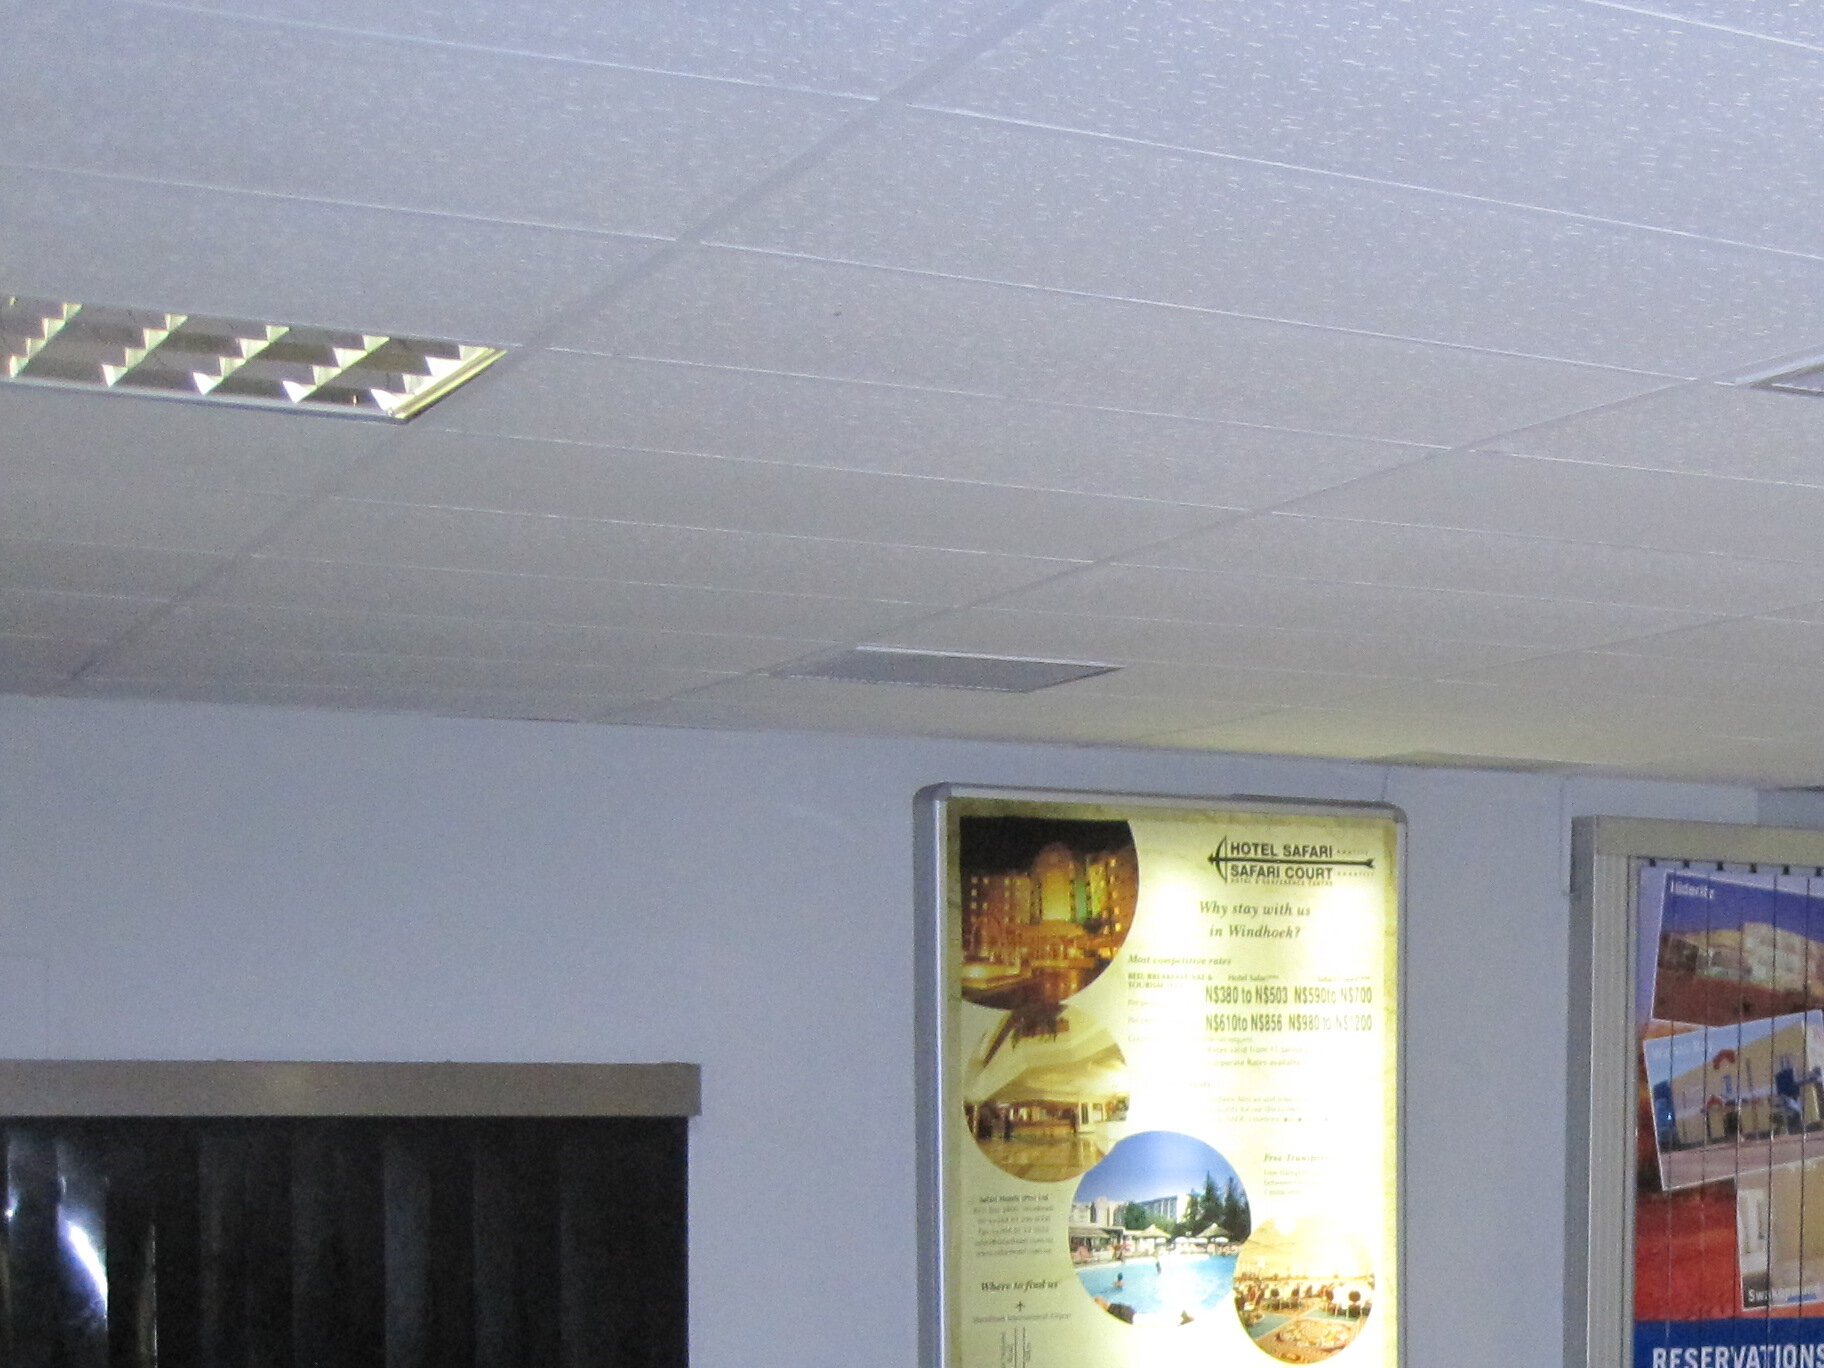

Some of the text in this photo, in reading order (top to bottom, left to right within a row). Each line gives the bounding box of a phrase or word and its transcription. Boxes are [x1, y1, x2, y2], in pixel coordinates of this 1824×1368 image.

[1230, 841, 1278, 857] HOTEL
[1283, 845, 1333, 859] SAFARI
[1230, 864, 1280, 878] SAFARI
[1285, 867, 1333, 880] COURT
[1199, 901, 1310, 918] Why stay with us
[1210, 924, 1301, 938] in Windhoek?
[1205, 986, 1238, 1003] N$380
[1242, 987, 1251, 1003] to
[1255, 986, 1288, 1004] N$503
[1251, 1013, 1283, 1031] N$856
[1289, 1013, 1319, 1031] N$980
[981, 1282, 1010, 1291] Where
